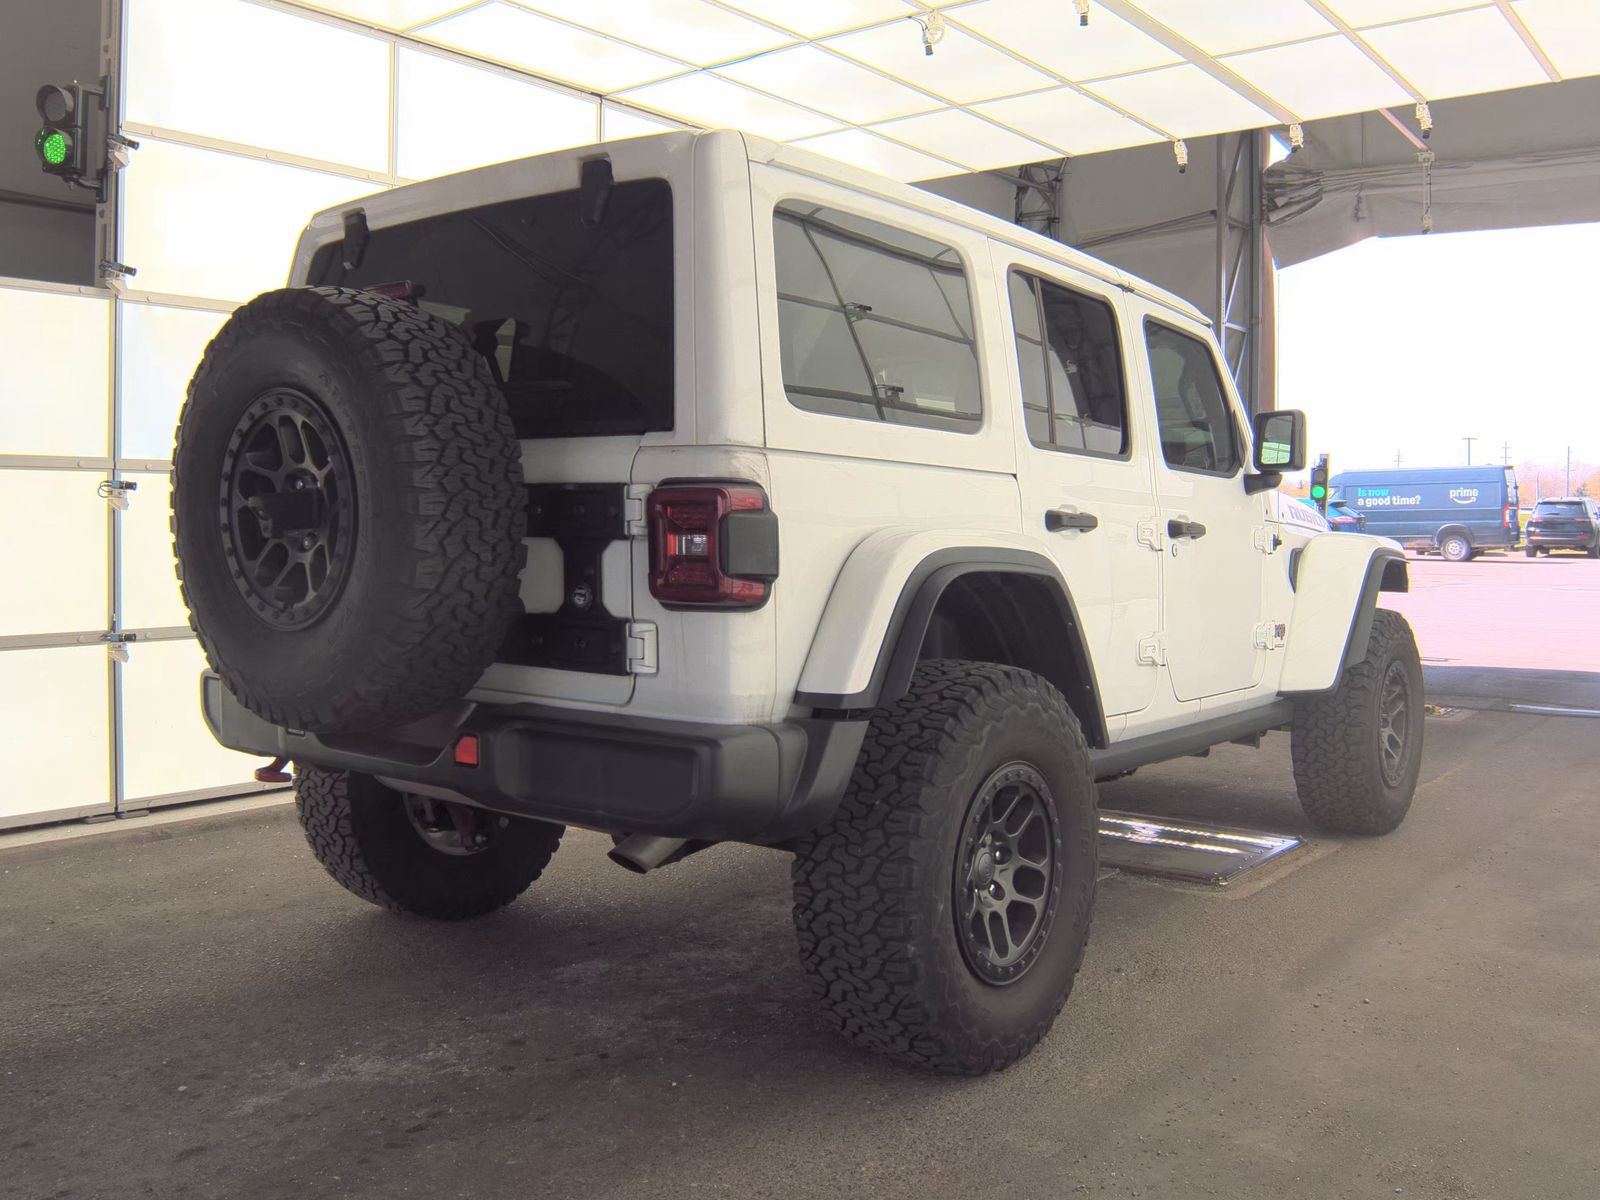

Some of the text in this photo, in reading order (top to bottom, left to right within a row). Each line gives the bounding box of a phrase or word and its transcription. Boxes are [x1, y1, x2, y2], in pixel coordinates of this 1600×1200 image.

[1368, 489, 1390, 497] now
[1449, 487, 1479, 499] prime
[1358, 495, 1422, 507] a good time?
